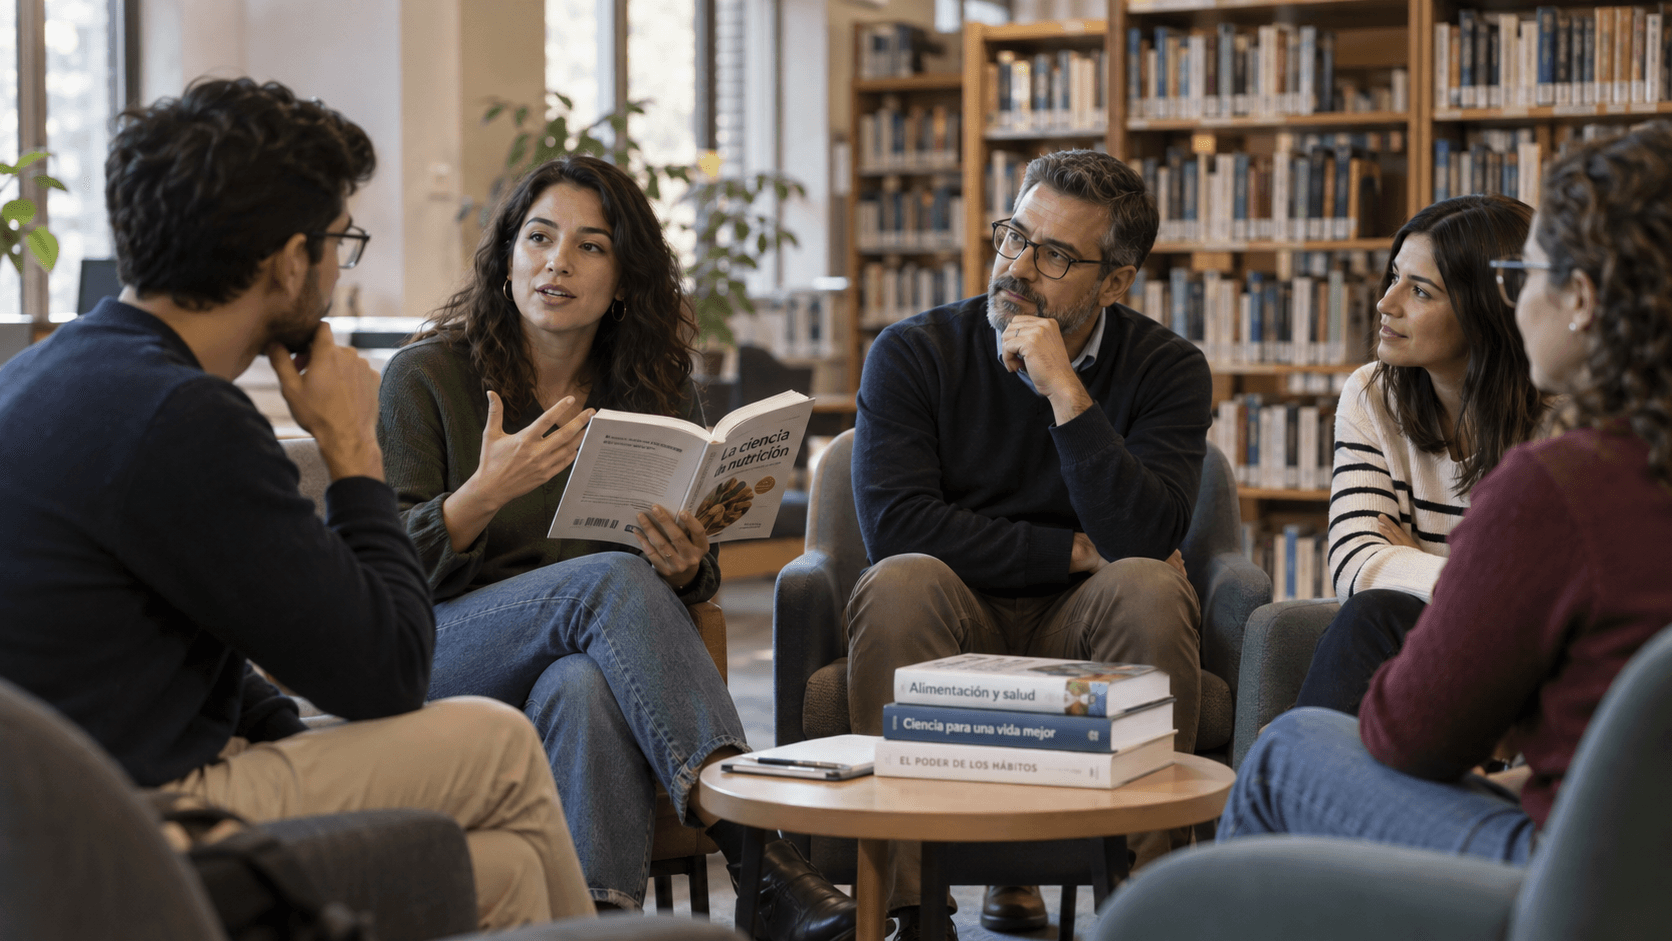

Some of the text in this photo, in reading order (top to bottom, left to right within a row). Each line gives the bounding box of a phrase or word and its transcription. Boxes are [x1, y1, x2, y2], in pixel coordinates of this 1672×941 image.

[721, 429, 790, 461] La ciencia
[727, 445, 789, 471] nutrición
[909, 682, 1036, 702] Alimentación y salud
[903, 717, 944, 732] Ciencia
[946, 722, 972, 735] para
[973, 724, 995, 735] una
[997, 723, 1020, 736] vida
[1022, 727, 1056, 741] mejor
[899, 756, 911, 766] EL
[915, 757, 949, 768] PODER
[952, 759, 966, 769] DE
[969, 760, 989, 770] LOS
[992, 760, 1038, 773] HÁBITOS
